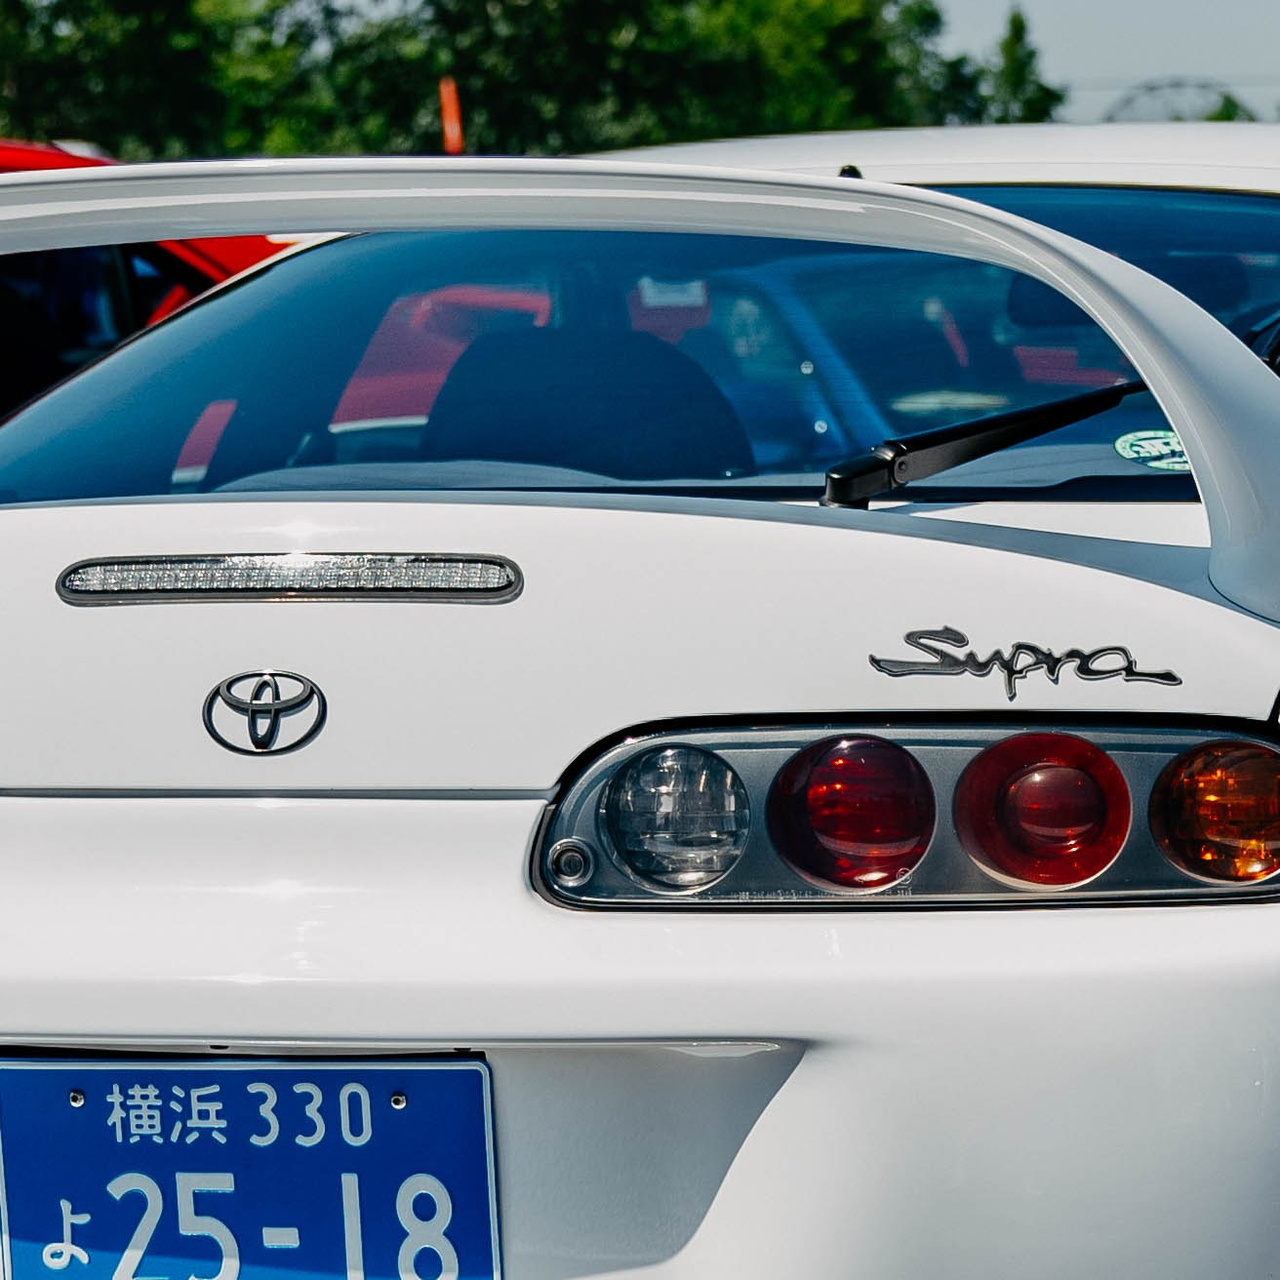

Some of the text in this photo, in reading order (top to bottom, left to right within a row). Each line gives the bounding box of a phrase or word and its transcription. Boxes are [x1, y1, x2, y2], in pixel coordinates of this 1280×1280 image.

[868, 624, 1183, 702] Supra
[106, 1082, 373, 1147] 横浜 330
[42, 1199, 92, 1271] よ
